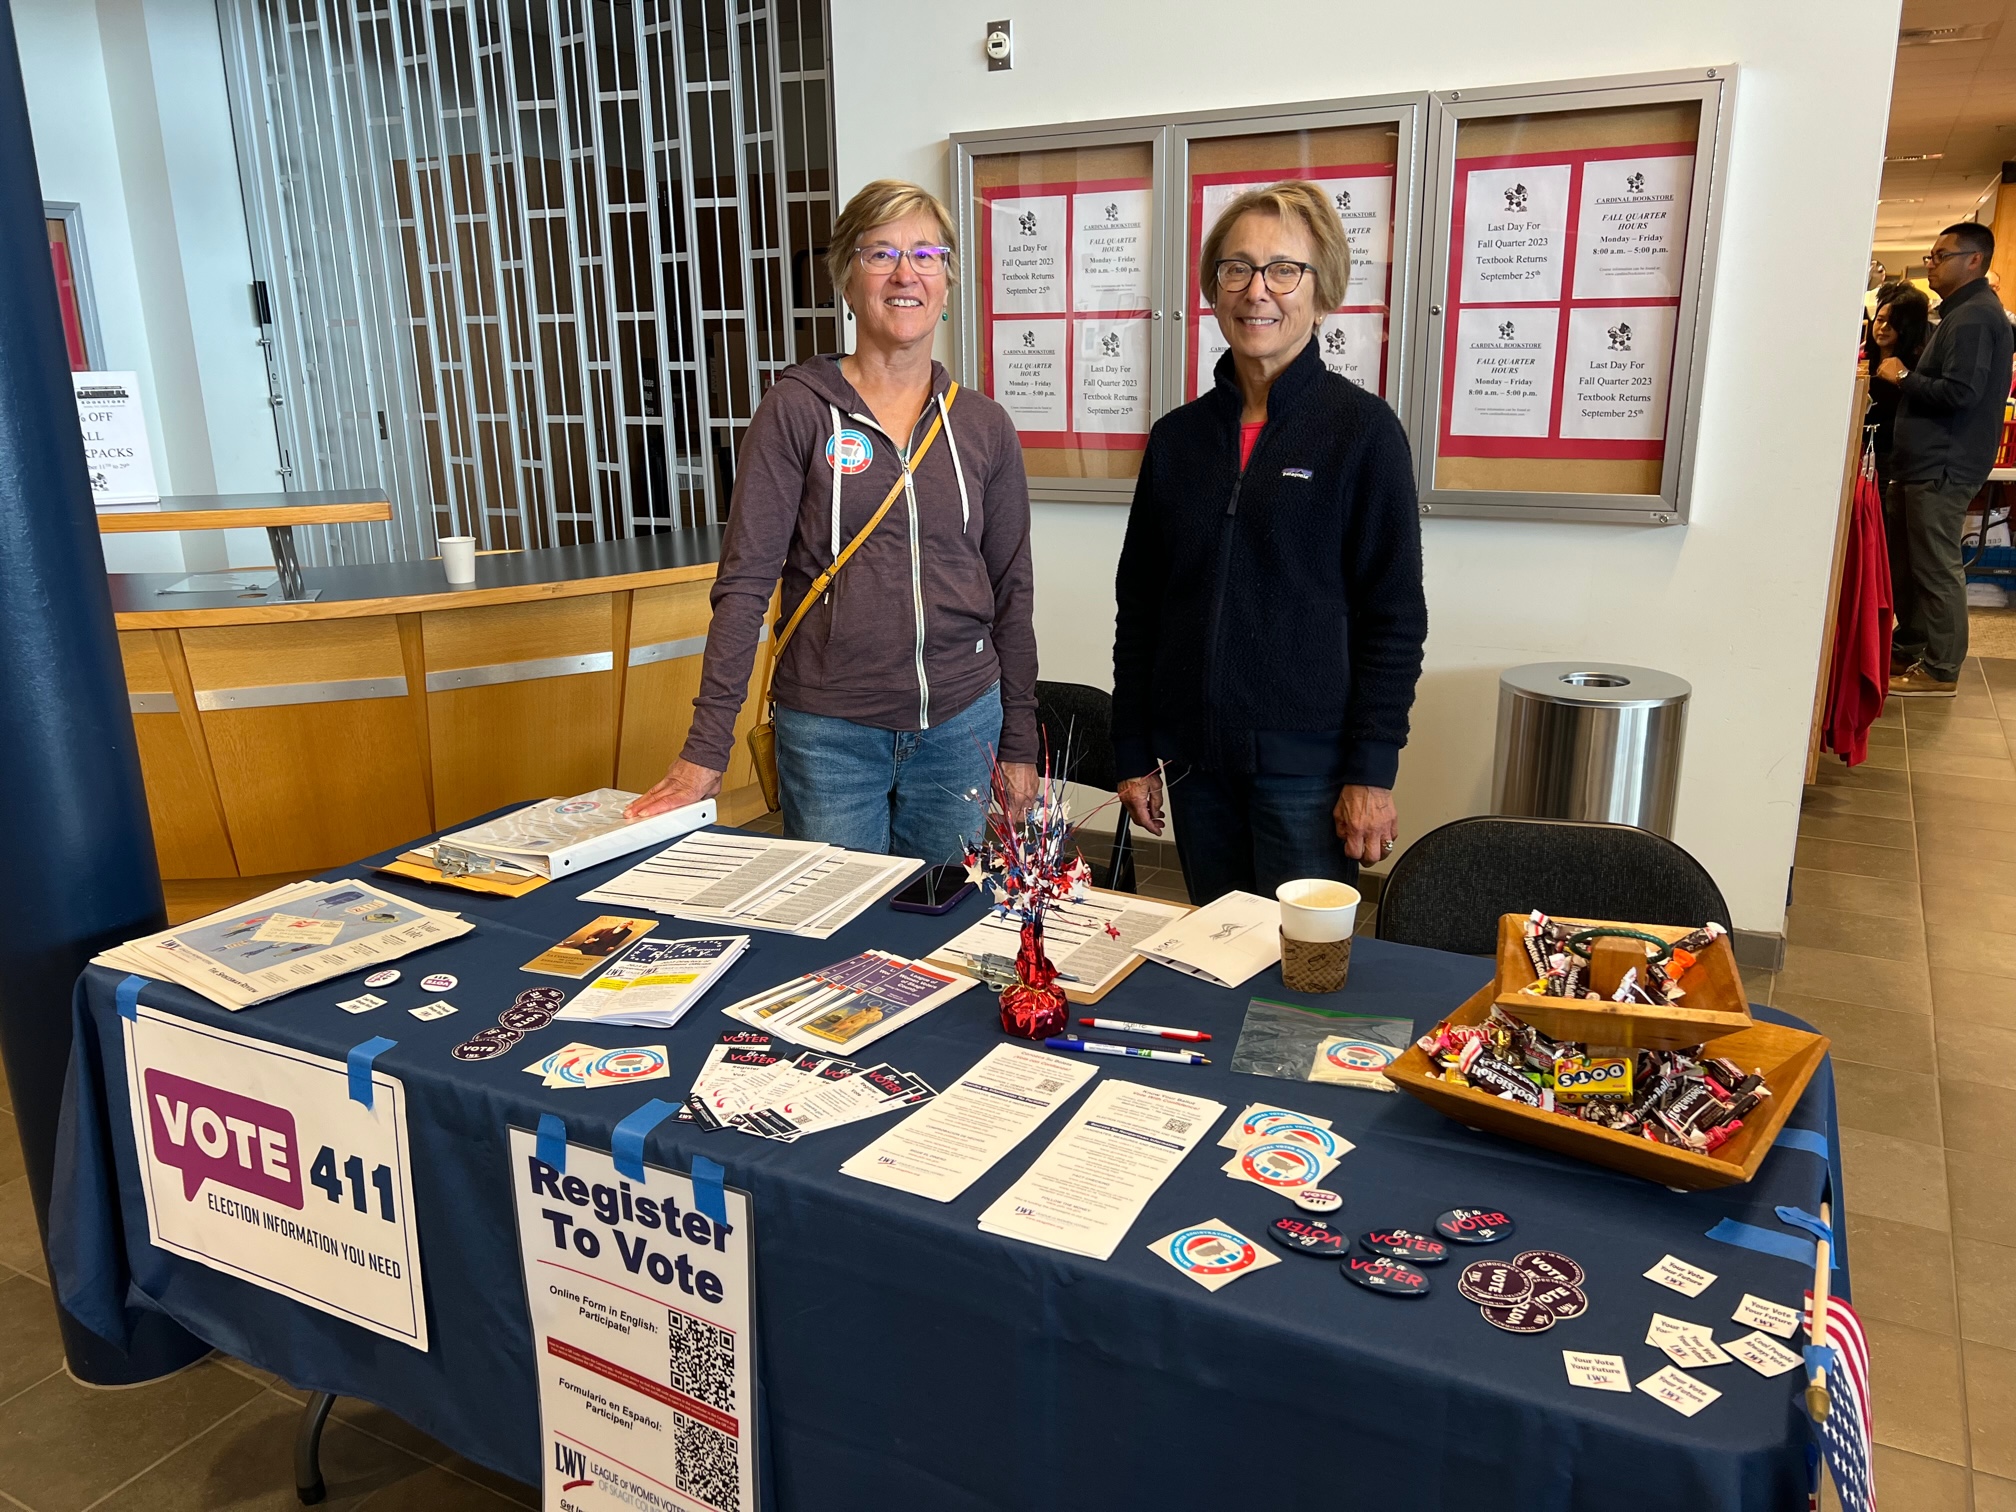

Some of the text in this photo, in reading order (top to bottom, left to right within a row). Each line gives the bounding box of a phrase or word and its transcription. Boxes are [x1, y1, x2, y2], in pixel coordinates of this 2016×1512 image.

[1625, 212, 1667, 222] QUARTER
[1488, 221, 1541, 233] Last Day For
[1618, 222, 1648, 230] HOURS
[1478, 237, 1548, 249] Fall Quarter 2023
[1639, 234, 1663, 243] Friday
[1023, 244, 1035, 253] Day
[1634, 246, 1650, 254] 5:00
[1651, 247, 1669, 257] p.m.
[1002, 257, 1054, 267] Fall Quarter 2023
[1476, 255, 1548, 264] Textbook Returns
[1002, 273, 1029, 281] Textbook
[1480, 270, 1541, 282] September 25th
[1006, 286, 1050, 296] September 25th
[1328, 364, 1343, 372] Day
[1497, 358, 1536, 366] QUARTER
[1590, 361, 1645, 371] Last Day For
[1105, 365, 1118, 374] Day
[1120, 365, 1131, 373] For
[1097, 379, 1120, 388] Quarter
[1122, 379, 1138, 387] 2023
[1476, 378, 1532, 386] Monday Friday
[1579, 377, 1652, 386] Fall Quarter 2023
[1083, 392, 1138, 402] Textbook Returns
[1578, 393, 1651, 402] Textbook Returns
[89, 412, 113, 422] OFF
[1087, 407, 1133, 415] September 25th
[1581, 409, 1644, 419] September 25th
[860, 995, 899, 1014] VOTE
[722, 1035, 769, 1043] VOTER
[730, 1054, 776, 1064] VOTER
[1559, 1064, 1625, 1087] DOTS
[868, 1071, 902, 1093] VOTER
[1632, 1078, 1672, 1119] Tootsie Roll
[155, 1094, 396, 1224] VOTE 411
[1303, 1191, 1337, 1200] VOTE
[528, 1156, 733, 1253] Register
[1442, 1212, 1510, 1233] VOTER
[208, 1192, 400, 1279] ELECTION INFORMATION YOU NEED
[1276, 1218, 1342, 1248] VOTER
[1370, 1232, 1443, 1254] VOTER
[542, 1208, 724, 1304] To Vote
[1350, 1259, 1423, 1287] VOTER
[1531, 1257, 1569, 1281] VOTE
[1488, 1269, 1508, 1293] VOTE
[549, 1285, 658, 1334] Online Form in English:
[1751, 1301, 1791, 1318] Your Vote
[579, 1307, 631, 1335] Participate!
[1744, 1306, 1793, 1326] Your Future
[1573, 1356, 1615, 1366] Your Vote
[1570, 1363, 1621, 1375] Your Future
[559, 1377, 607, 1405] Formulario
[609, 1401, 620, 1412] en
[622, 1405, 662, 1432] Español:
[586, 1401, 633, 1430] Participen!
[555, 1441, 587, 1481] LWV
[590, 1462, 619, 1486] LEAGUE
[629, 1483, 660, 1505] WOMEN
[598, 1480, 634, 1506] OF SKAGIT
[560, 1499, 574, 1512] Get
